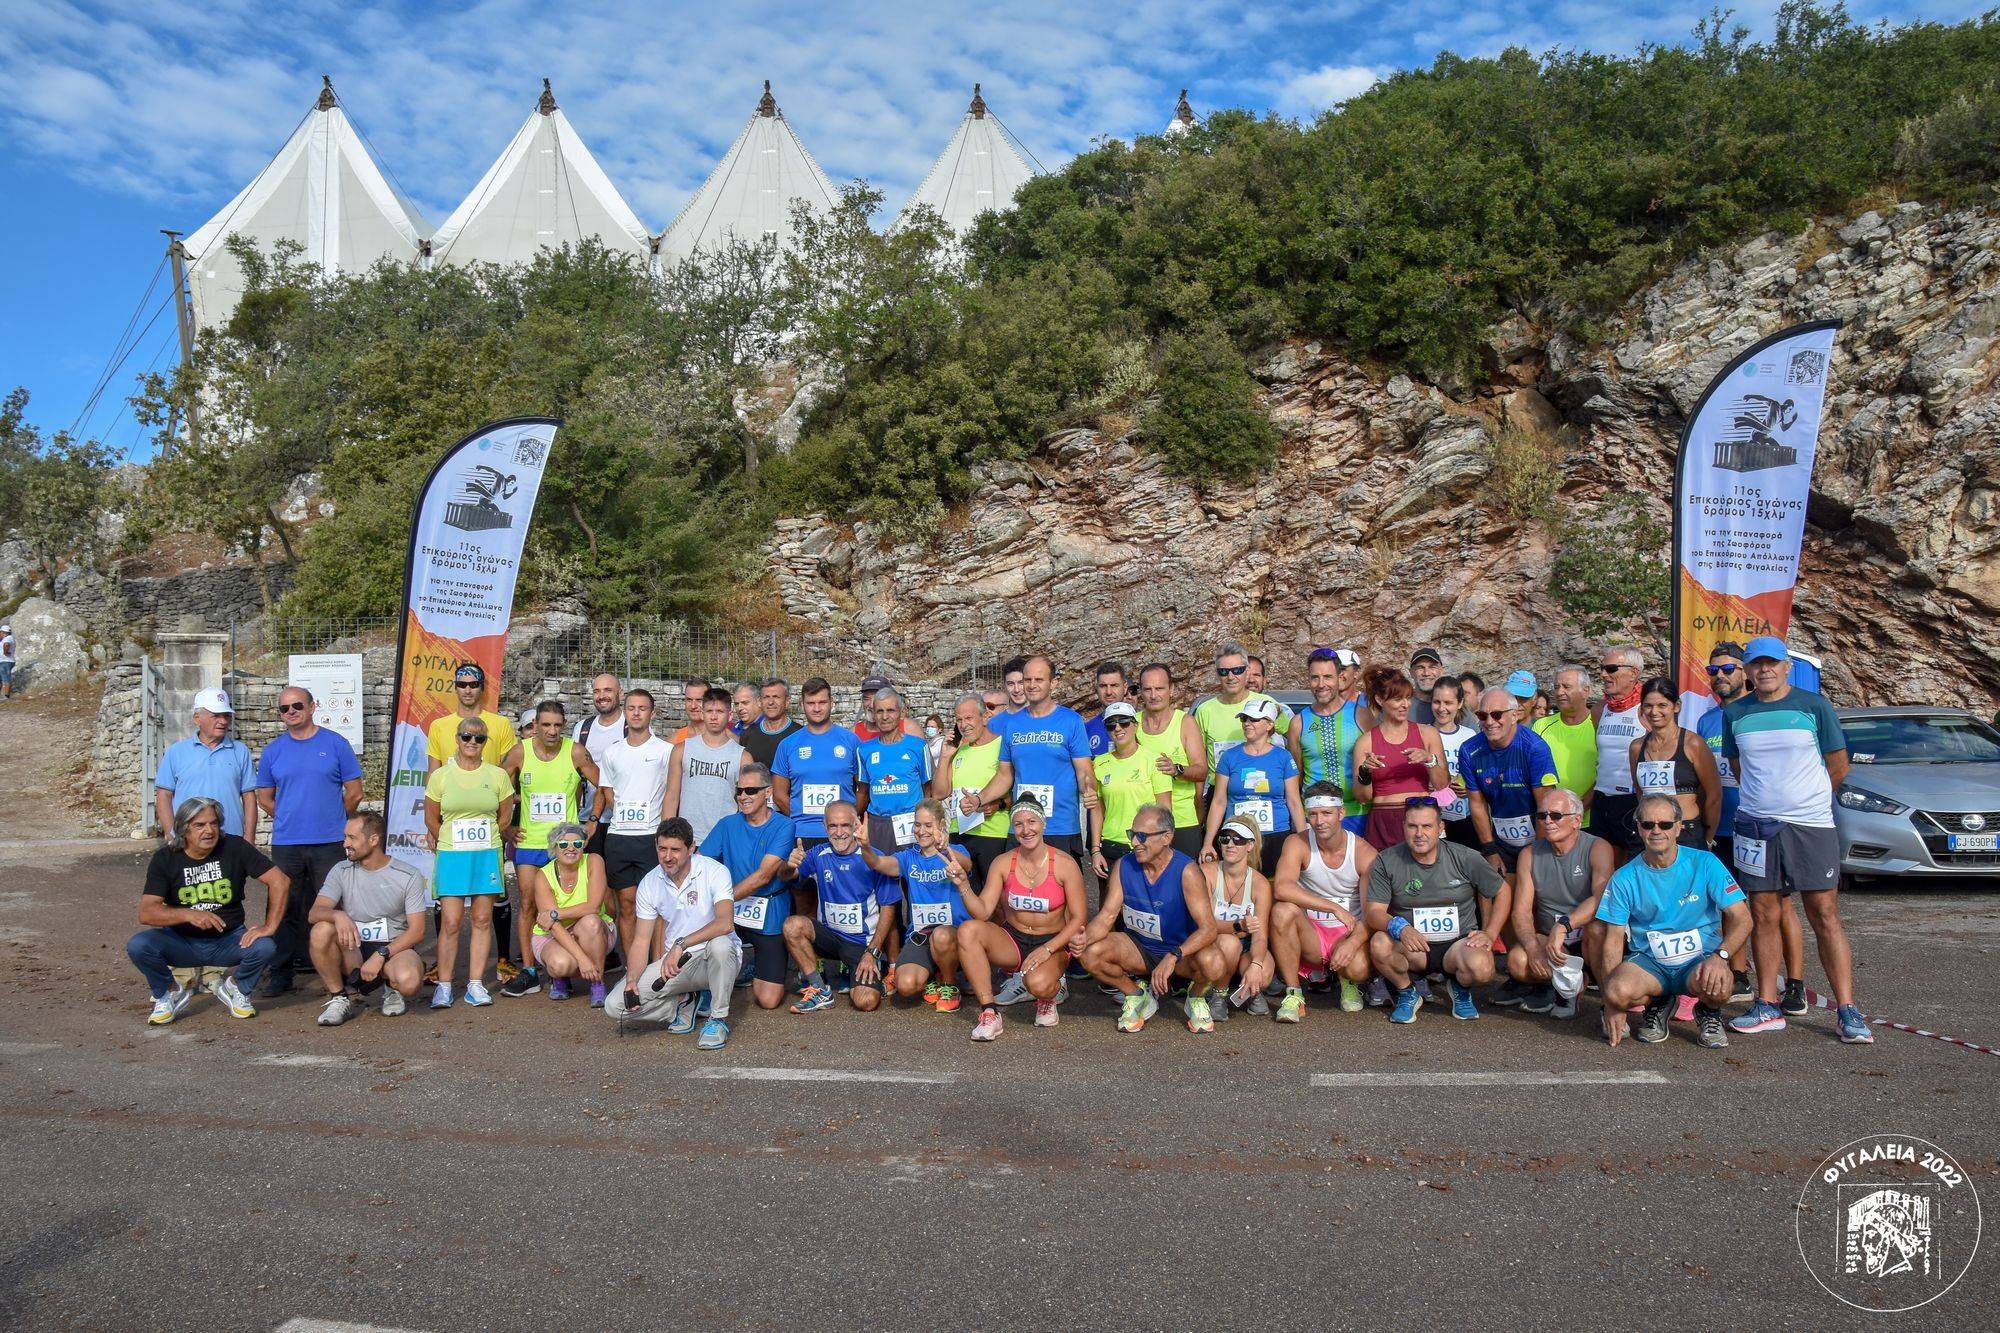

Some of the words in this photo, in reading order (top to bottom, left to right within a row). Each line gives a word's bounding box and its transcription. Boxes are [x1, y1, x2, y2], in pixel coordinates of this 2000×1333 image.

[1733, 486, 1761, 498] 11ος
[1689, 495, 1751, 508] Επικούριος
[1757, 498, 1802, 510] αγώνας
[1703, 505, 1745, 517] δρόμου
[1751, 507, 1786, 520] 15χλμ
[460, 542, 482, 554] 11ος
[421, 545, 473, 562] Επικούριος
[476, 554, 513, 568] αγώνας
[431, 556, 468, 570] δρόμου
[411, 654, 479, 671] ΦΥΓΑΛ
[425, 677, 454, 694] 202
[689, 757, 731, 780] EVERLAST
[1640, 771, 1669, 786] 123
[807, 793, 835, 806] 162
[535, 801, 562, 814] 110
[619, 809, 645, 821] 196
[457, 827, 486, 841] 160
[1501, 825, 1530, 839] 103
[1736, 845, 1760, 865] 177
[183, 861, 221, 878] FUNZONE
[185, 870, 223, 886] GAMBLER
[1012, 896, 1043, 911] 159
[735, 904, 761, 920] 158
[830, 911, 857, 925] 128
[917, 911, 947, 924] 166
[1127, 915, 1155, 933] 107
[1420, 917, 1454, 932] 199
[361, 926, 382, 941] 97
[1658, 935, 1696, 957] 173
